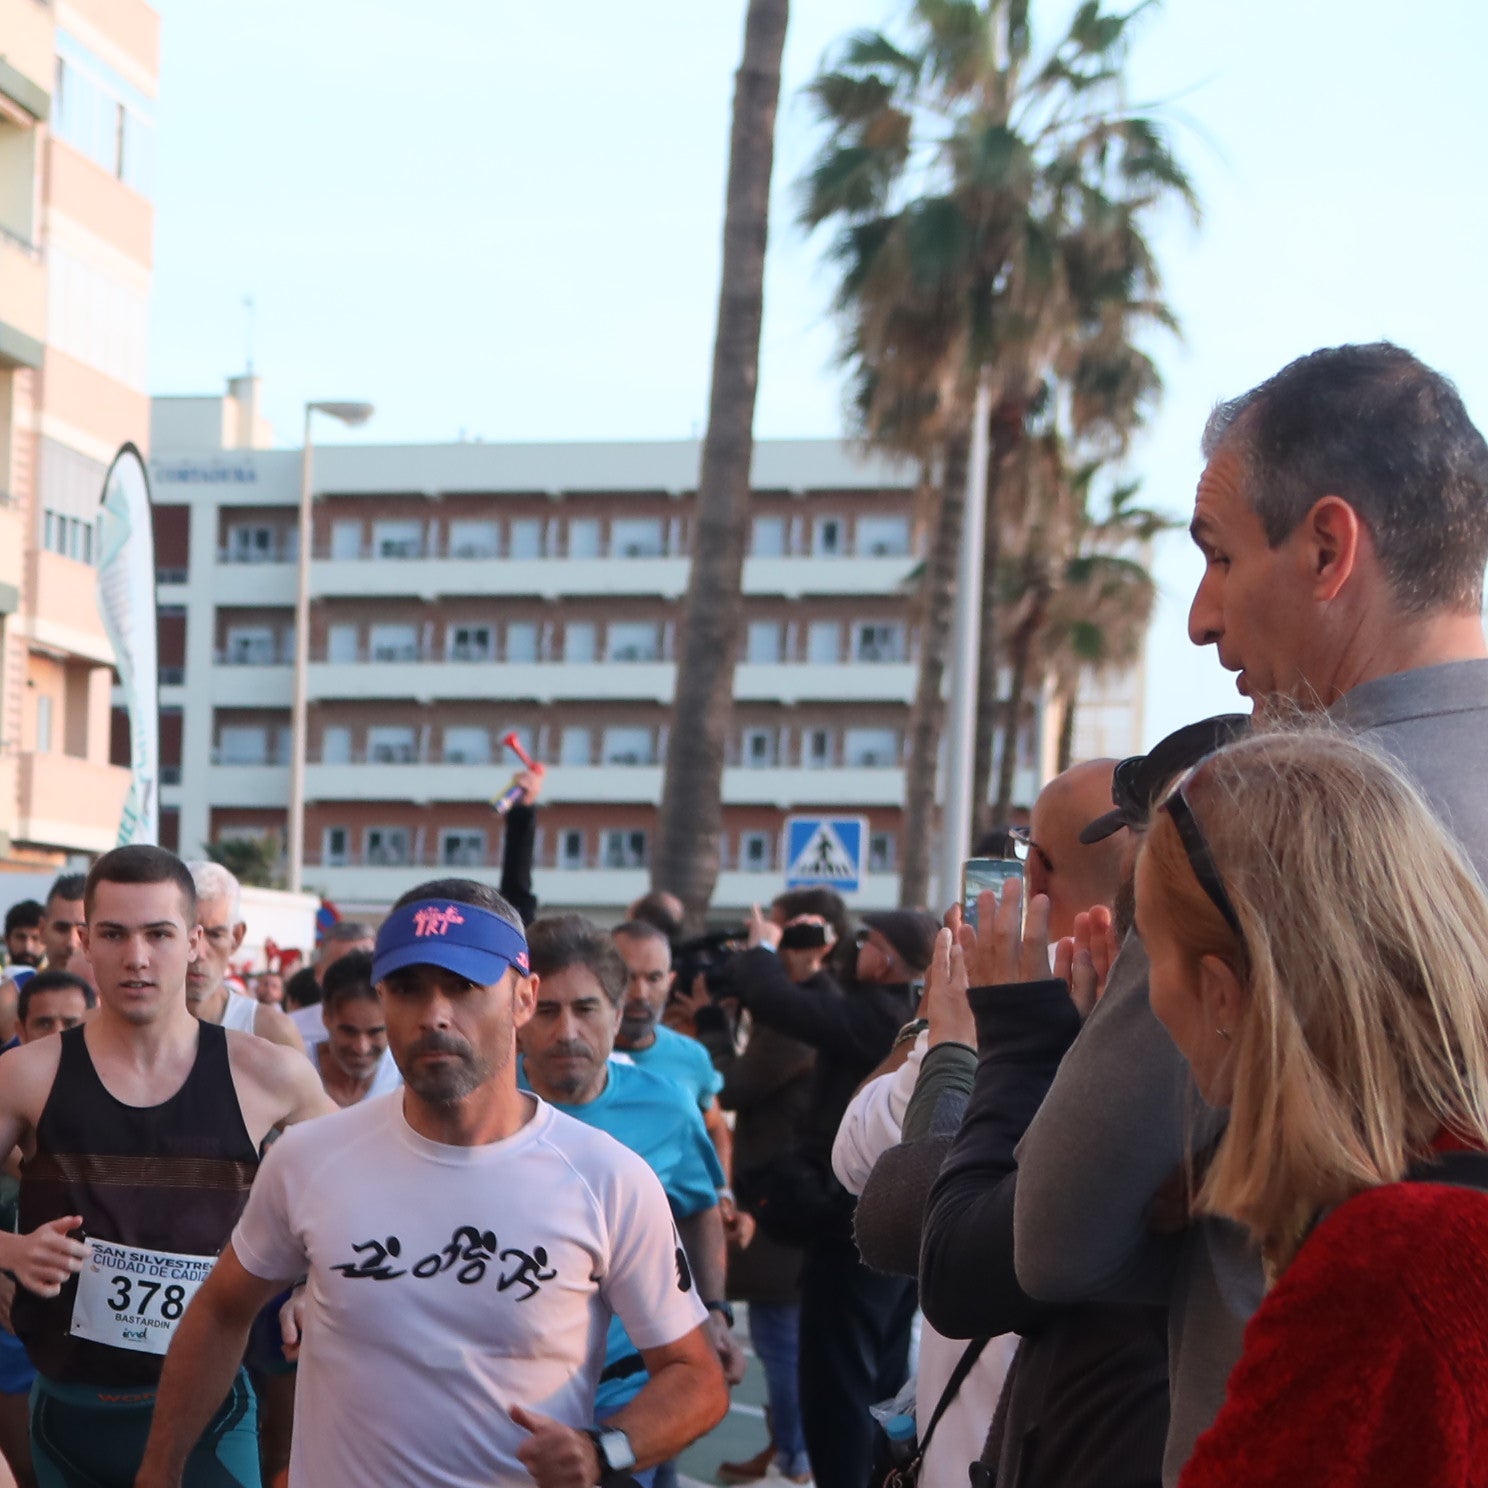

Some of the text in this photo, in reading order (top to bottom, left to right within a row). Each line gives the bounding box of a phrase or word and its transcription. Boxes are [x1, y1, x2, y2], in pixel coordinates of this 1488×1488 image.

[93, 1254, 145, 1274] CIUDAD
[149, 1265, 168, 1278] DE
[107, 1275, 185, 1320] 378
[114, 1312, 171, 1330] BASTARDIN
